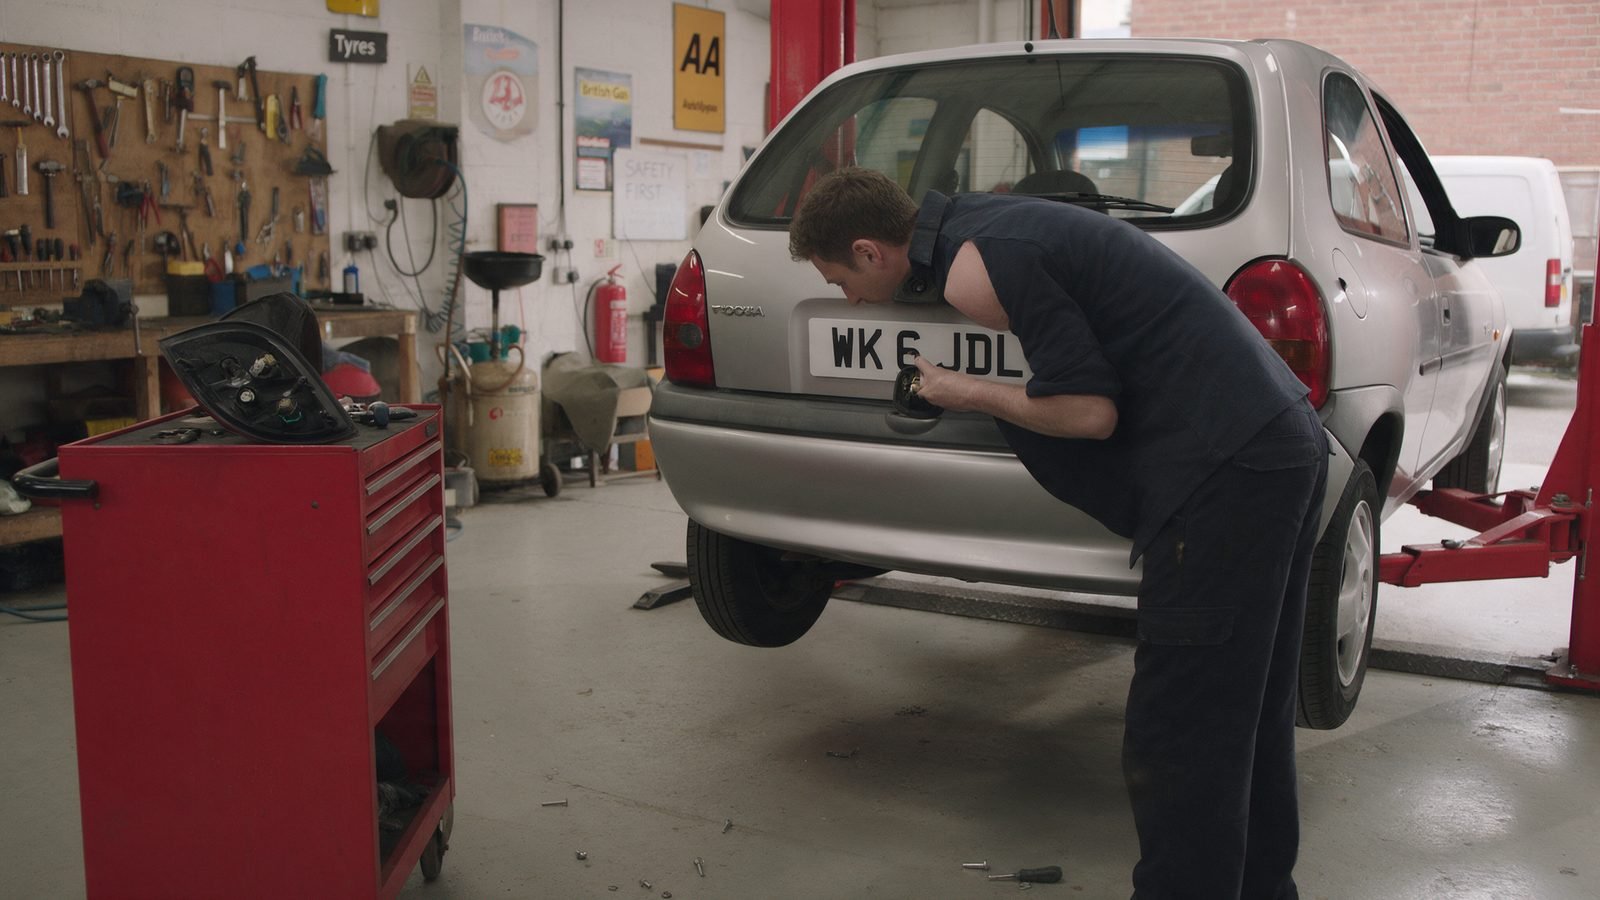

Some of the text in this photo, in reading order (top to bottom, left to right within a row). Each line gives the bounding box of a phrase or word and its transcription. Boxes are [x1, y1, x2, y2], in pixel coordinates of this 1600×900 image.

[334, 34, 376, 59] Tyres
[681, 33, 720, 76] AA
[625, 159, 674, 179] SAFETY
[625, 182, 662, 200] FIRST
[936, 332, 1023, 378] JDL
